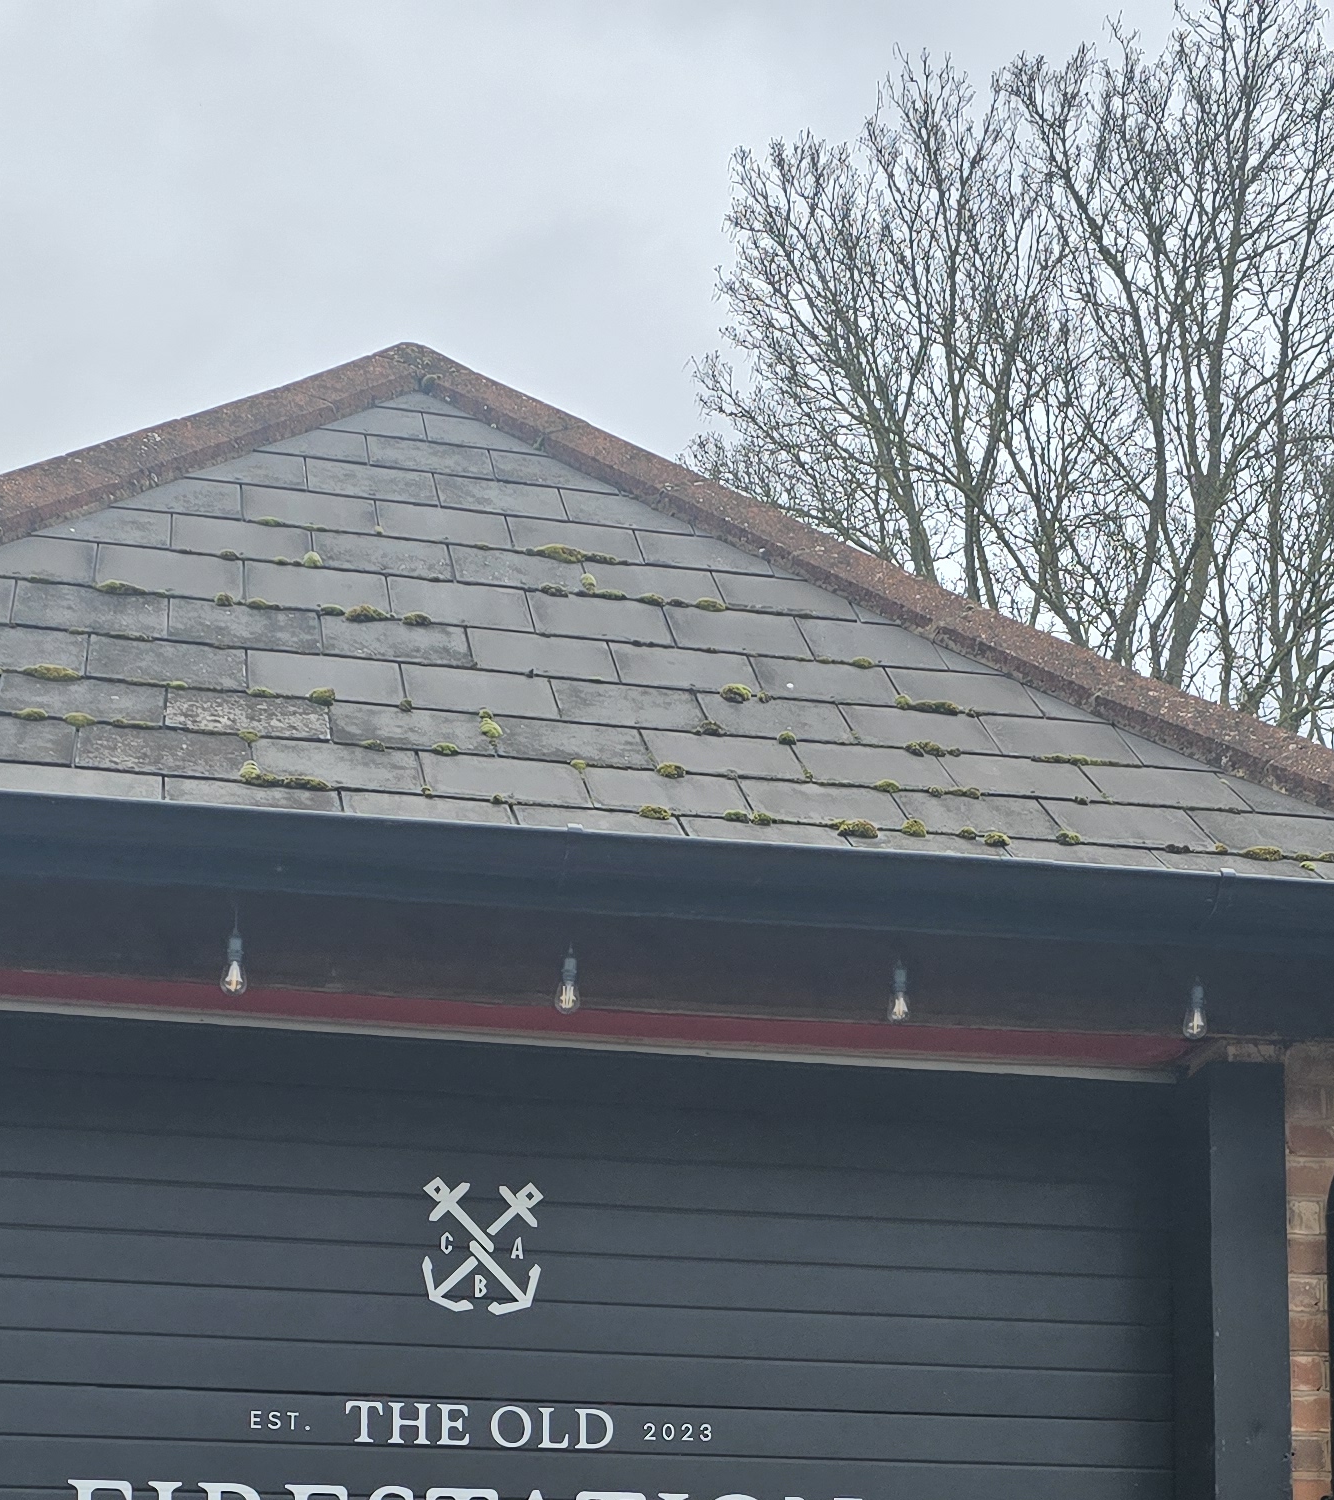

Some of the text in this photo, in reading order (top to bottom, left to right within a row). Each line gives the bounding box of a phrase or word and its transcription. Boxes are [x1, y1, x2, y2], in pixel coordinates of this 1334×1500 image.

[441, 1231, 524, 1259] C A
[474, 1275, 487, 1298] B
[250, 1400, 713, 1449] EST. THE OLD 2023
